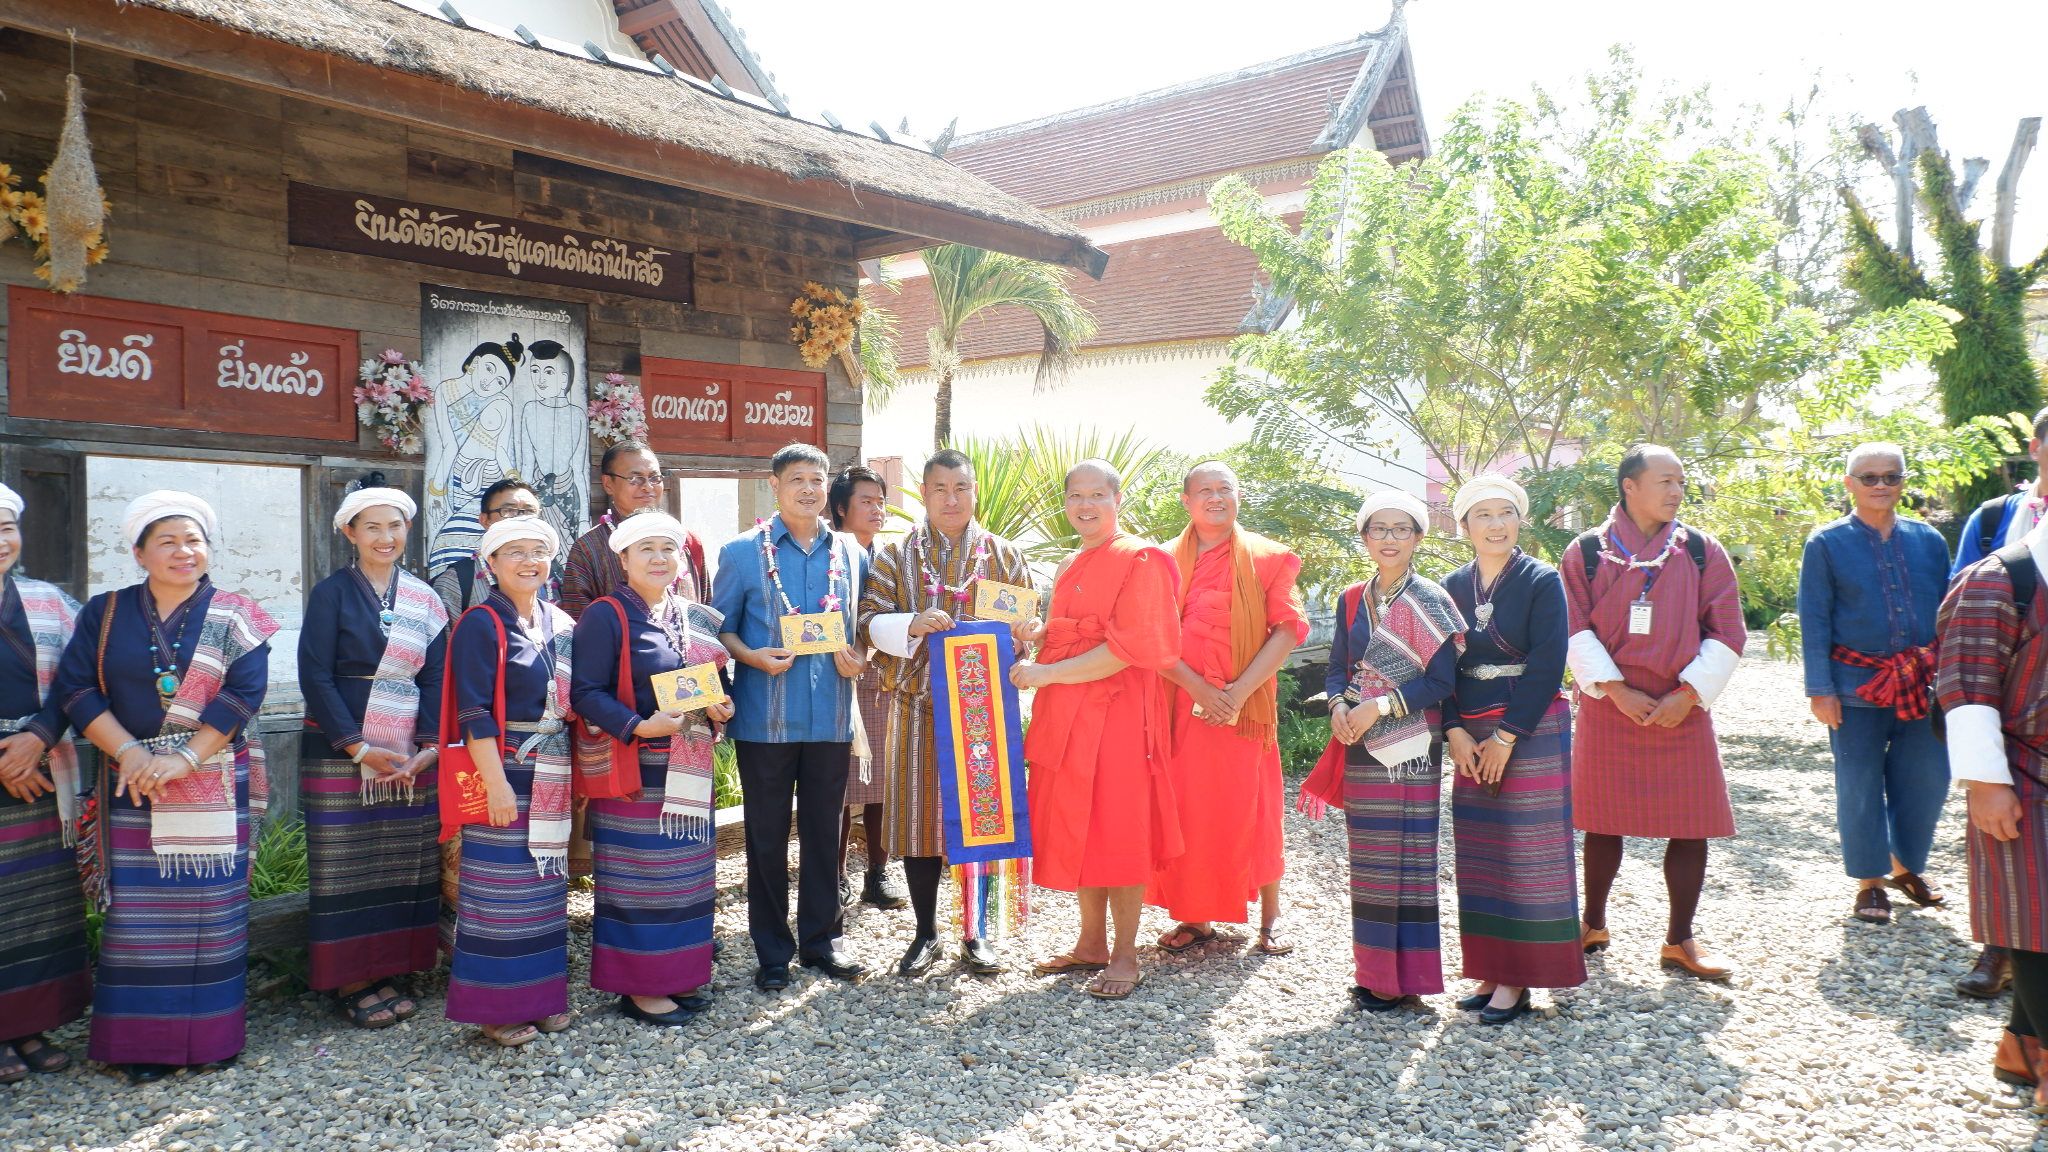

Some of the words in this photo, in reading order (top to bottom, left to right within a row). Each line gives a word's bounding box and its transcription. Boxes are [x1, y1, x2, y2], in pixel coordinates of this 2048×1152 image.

[57, 329, 154, 381] ยินดี
[216, 340, 324, 397] ยิ่งแล้ว
[651, 383, 728, 423] แขกแก้ว
[744, 390, 813, 427] มาเยือน
